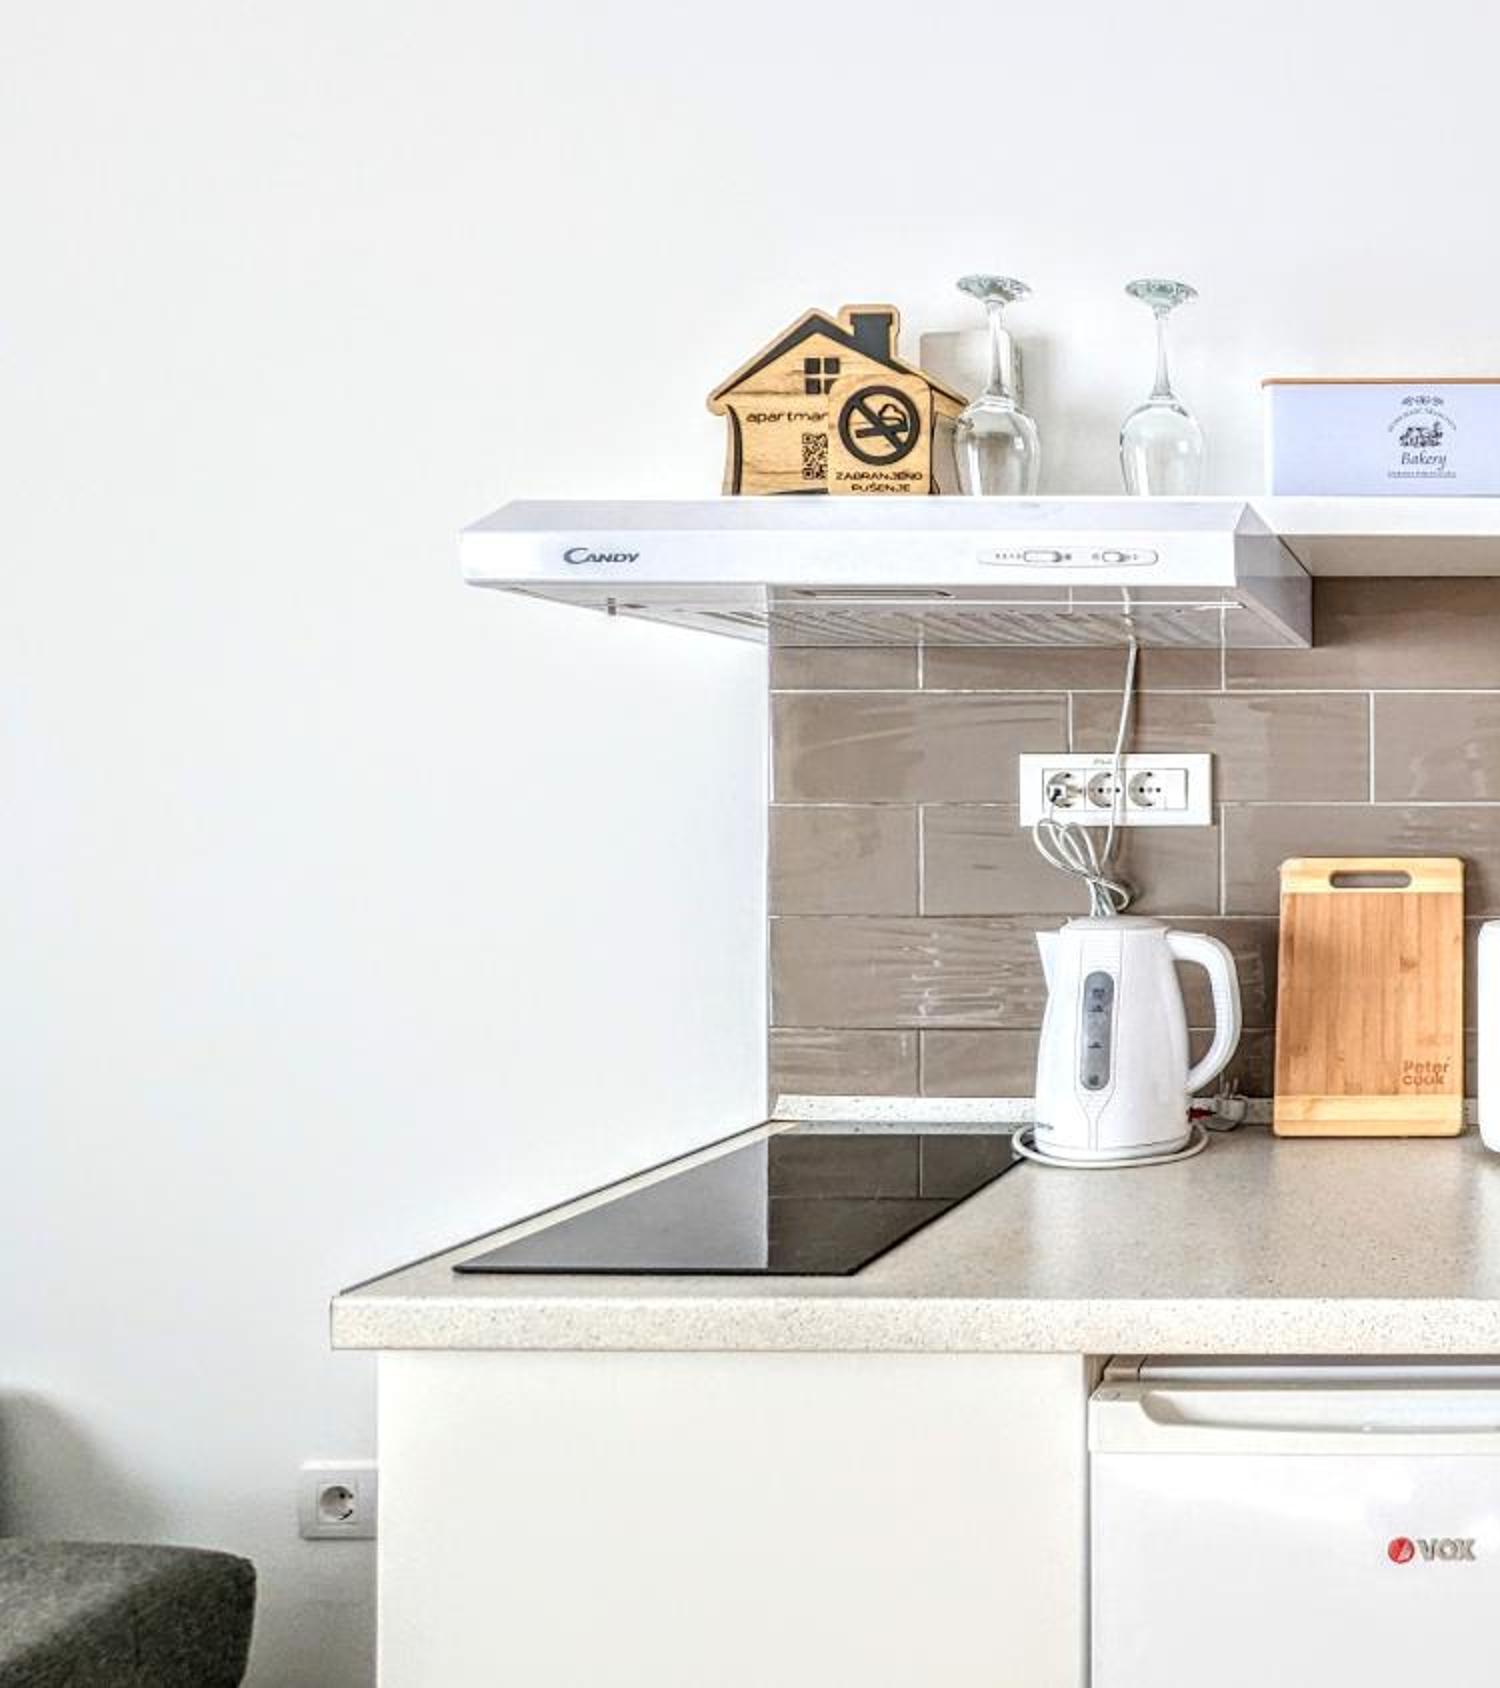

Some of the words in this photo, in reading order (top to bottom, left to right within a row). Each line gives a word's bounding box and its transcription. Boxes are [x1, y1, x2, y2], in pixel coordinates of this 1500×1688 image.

[1401, 449, 1447, 471] Bakery
[836, 471, 923, 481] ZABRANJENO
[1403, 1060, 1450, 1073] Peter
[1402, 1072, 1445, 1086] cook
[1416, 1538, 1476, 1561] VOX
